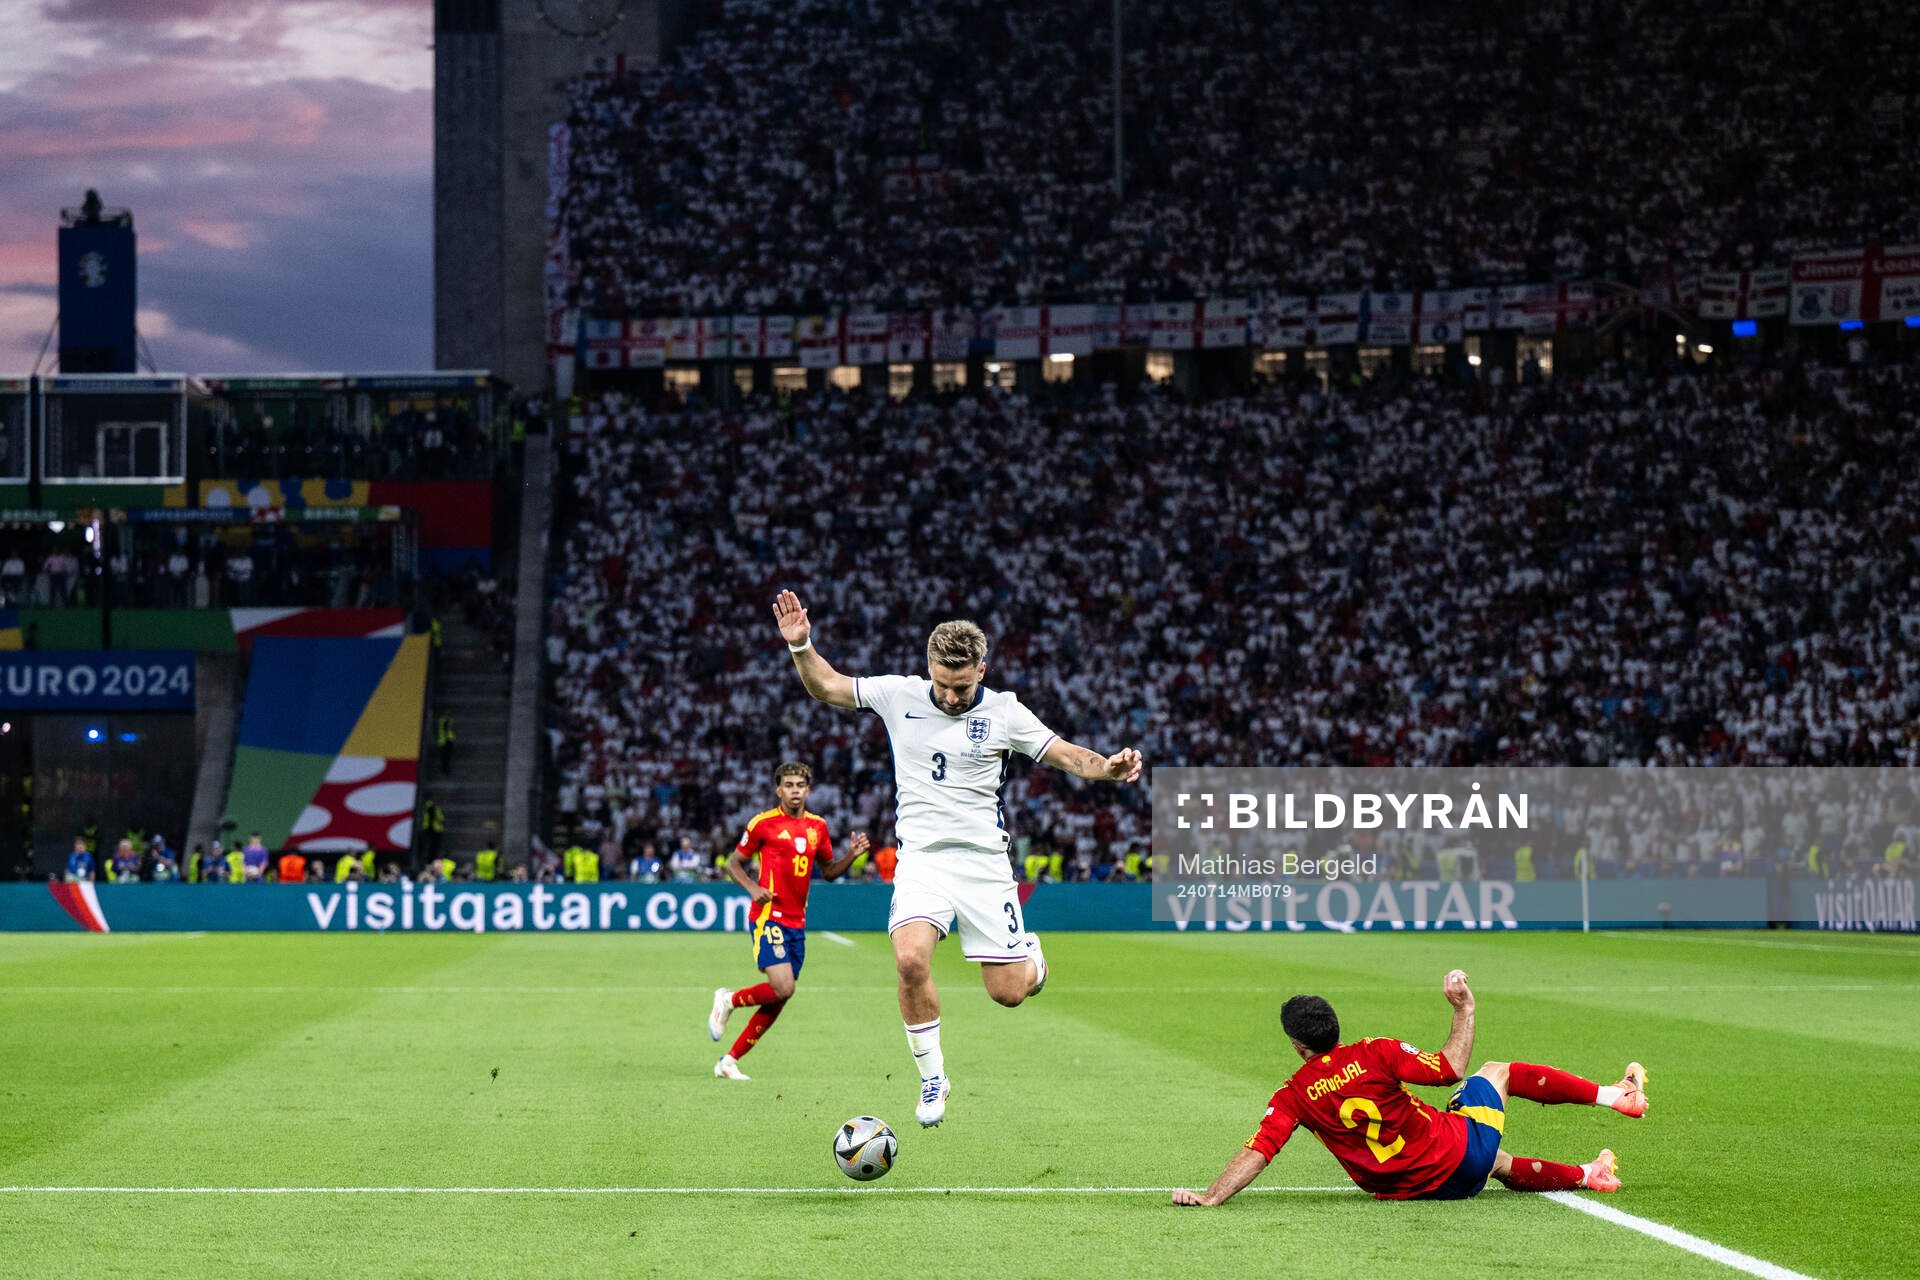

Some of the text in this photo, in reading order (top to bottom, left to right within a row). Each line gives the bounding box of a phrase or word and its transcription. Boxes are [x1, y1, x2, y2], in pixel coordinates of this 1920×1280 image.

[0, 665, 190, 696] URO2024
[931, 752, 946, 781] 3
[792, 854, 809, 877] 19
[1004, 901, 1018, 934] 3
[764, 925, 785, 945] 19
[1306, 1060, 1367, 1101] CARVAJAL
[1339, 1097, 1406, 1164] 2
